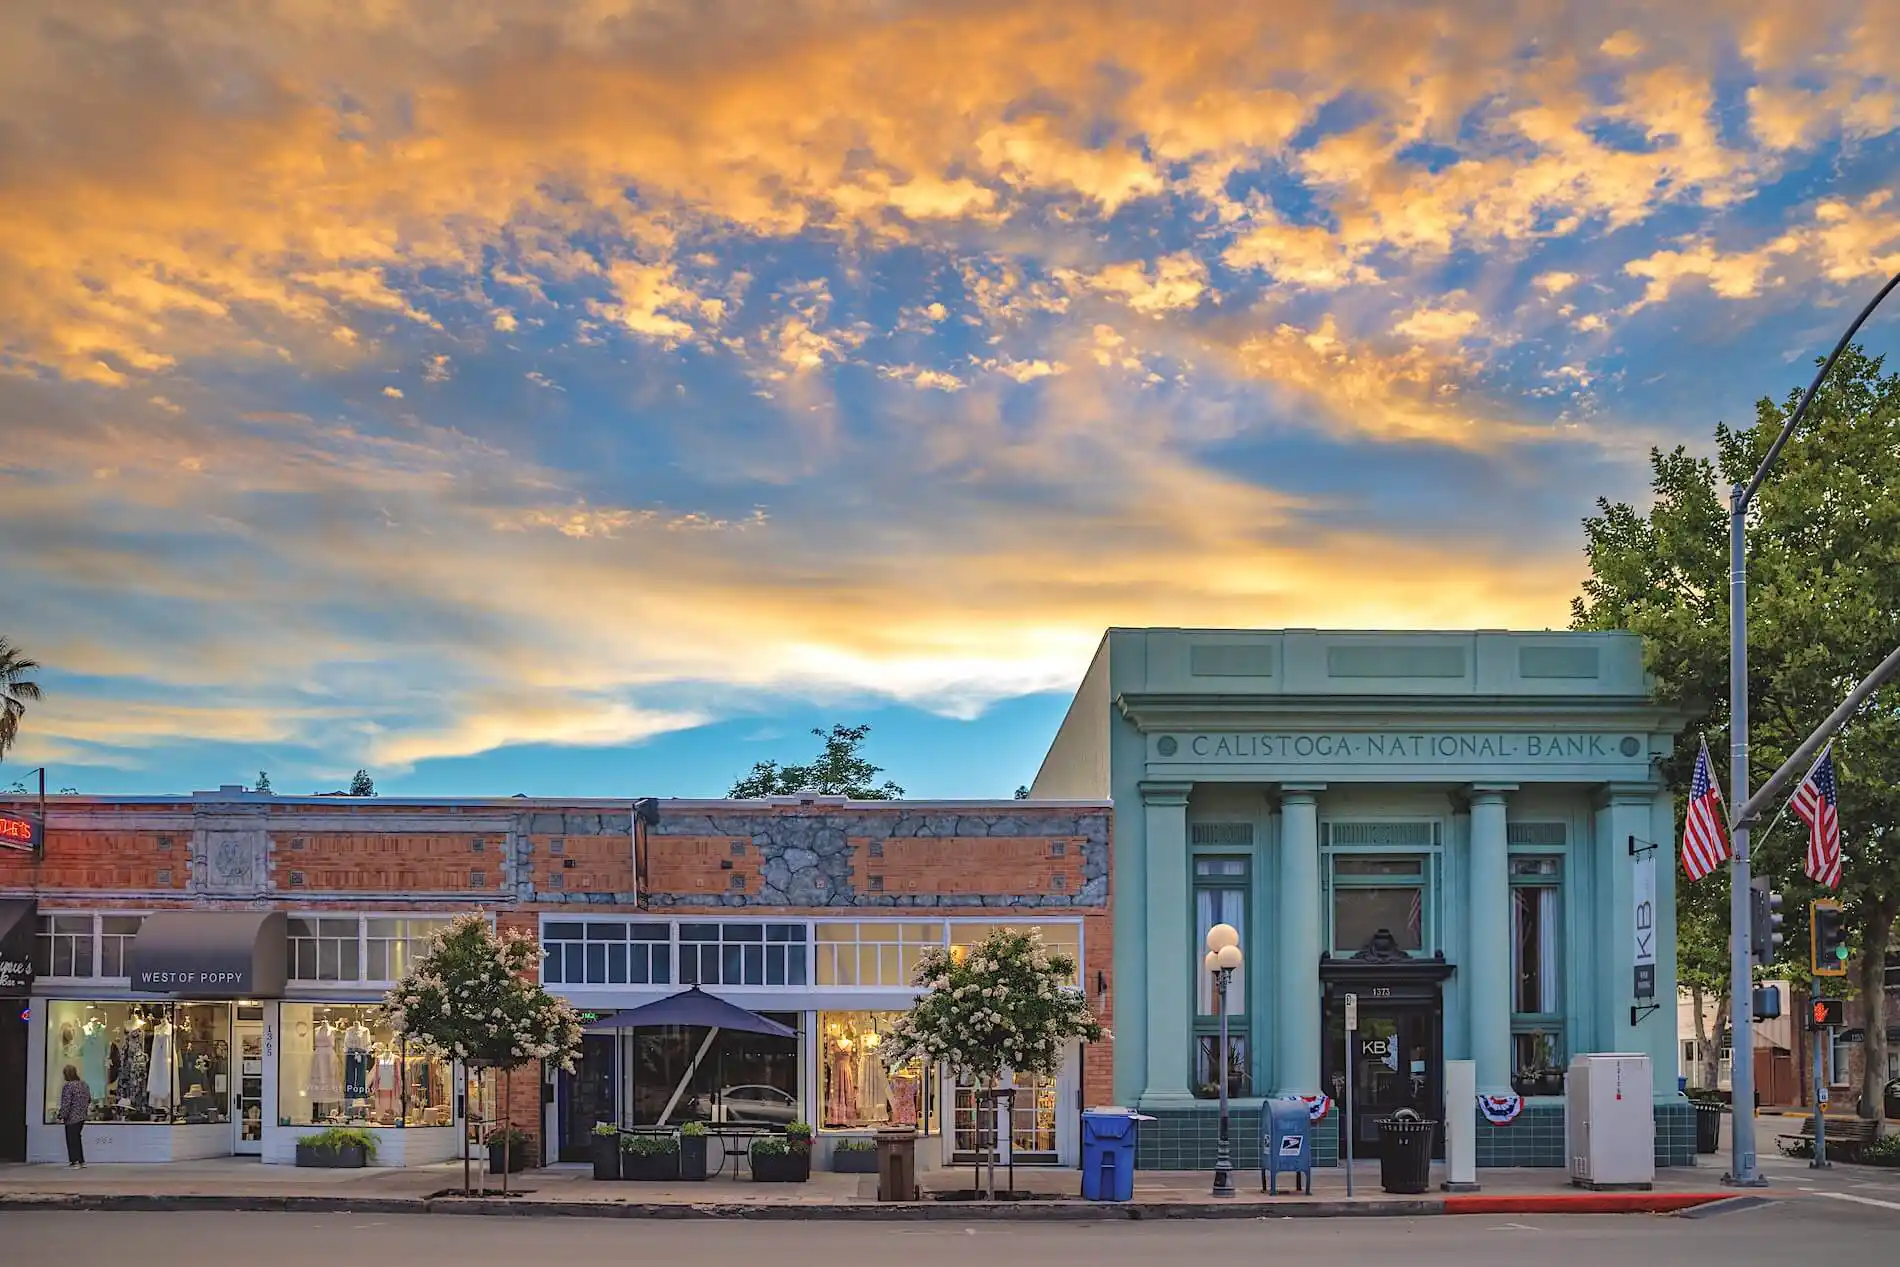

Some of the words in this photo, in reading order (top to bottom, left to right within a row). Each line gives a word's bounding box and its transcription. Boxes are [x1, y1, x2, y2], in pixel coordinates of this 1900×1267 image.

[1192, 735, 1351, 756] CALISTOGA
[1367, 735, 1512, 756] NATIONAL
[1527, 735, 1606, 756] BANK
[1636, 901, 1652, 959] KB
[141, 972, 177, 983] WEST
[178, 972, 195, 983] OF
[200, 972, 242, 983] POPPY
[1372, 987, 1391, 997] 1373
[1362, 1040, 1387, 1055] KB
[346, 1084, 376, 1096] Poppy
